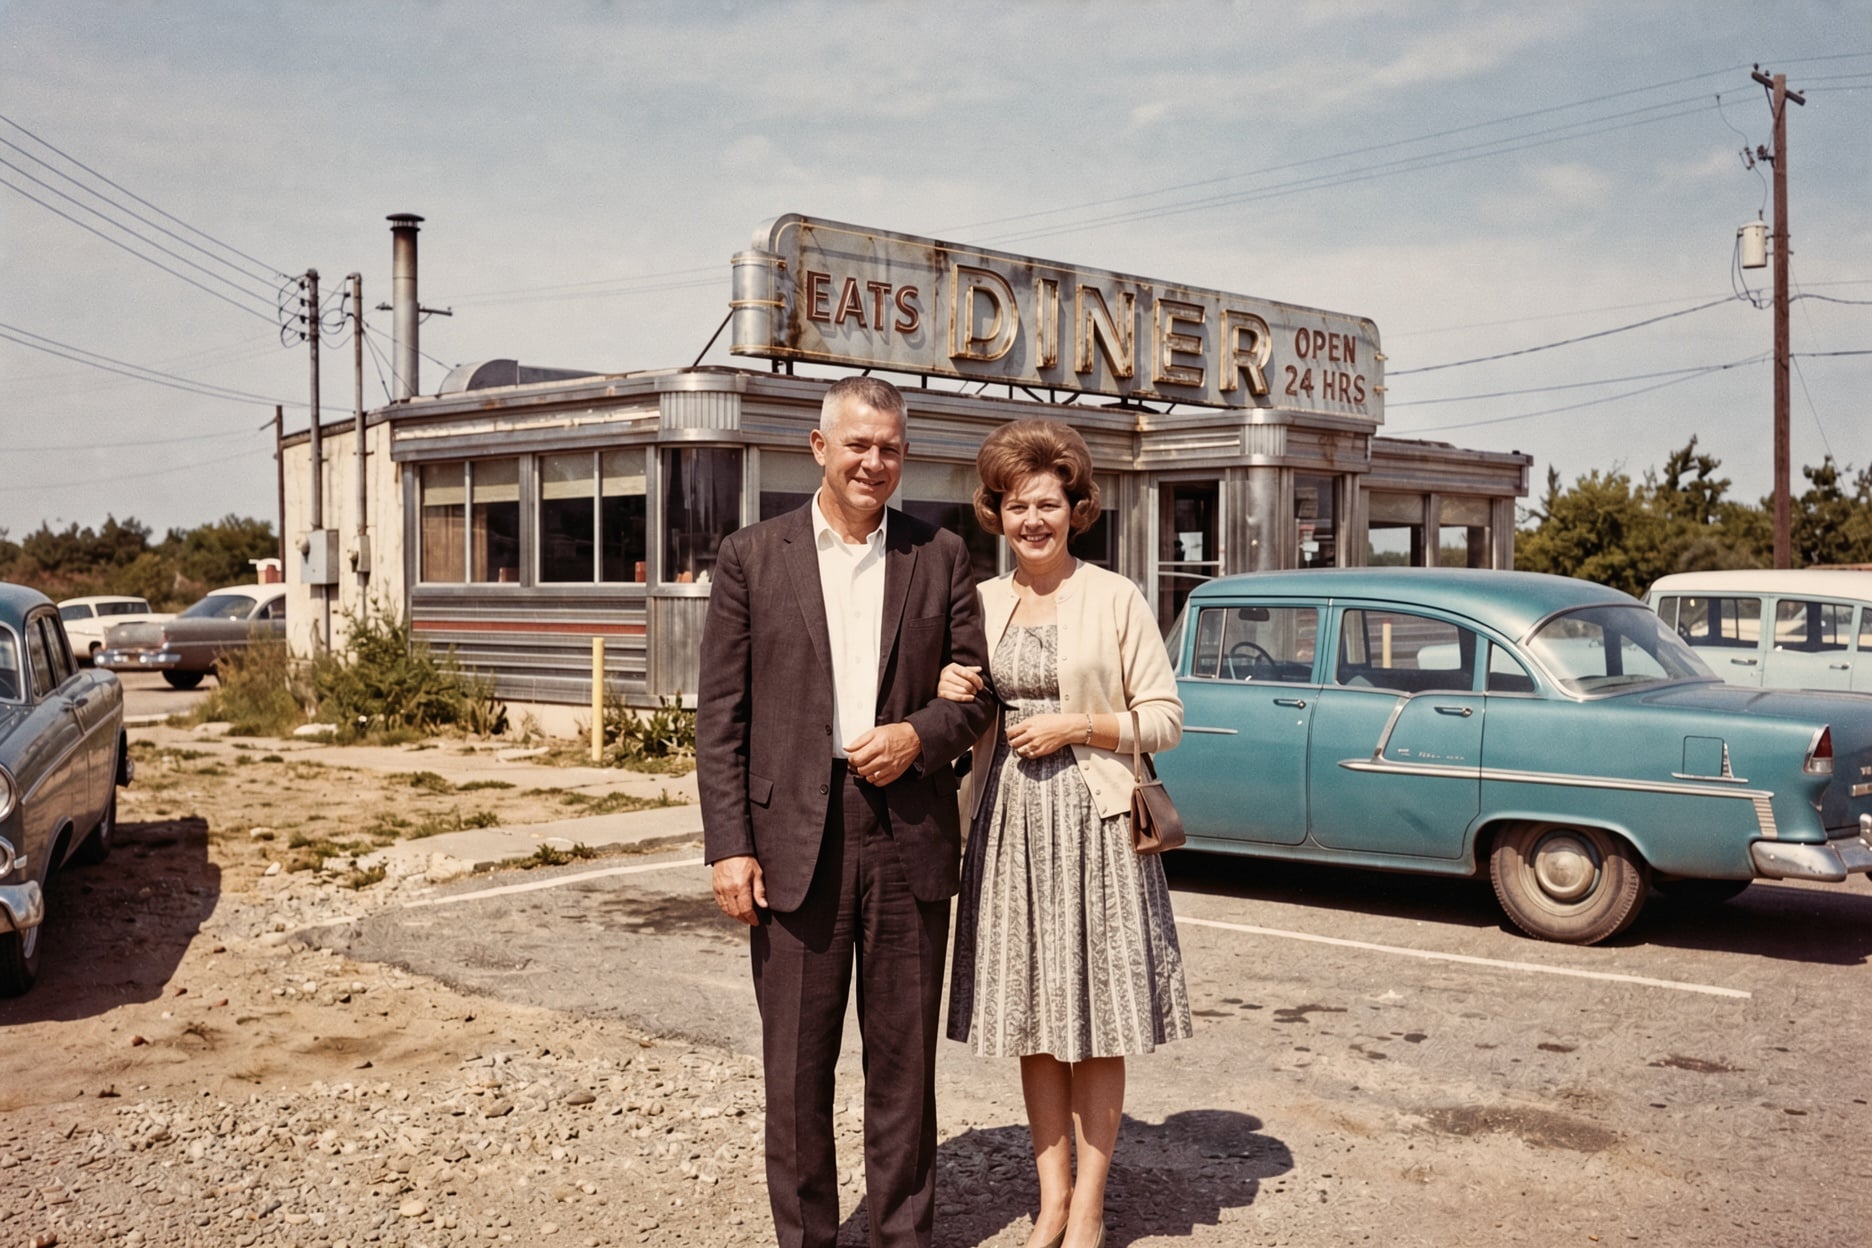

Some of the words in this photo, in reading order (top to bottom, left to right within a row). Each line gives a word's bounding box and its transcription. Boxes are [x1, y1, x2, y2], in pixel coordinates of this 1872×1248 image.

[806, 270, 920, 334] EATS
[948, 263, 1272, 396] DINER
[1294, 327, 1356, 364] OPEN
[1284, 364, 1315, 398] 24
[1322, 369, 1366, 405] HRS
